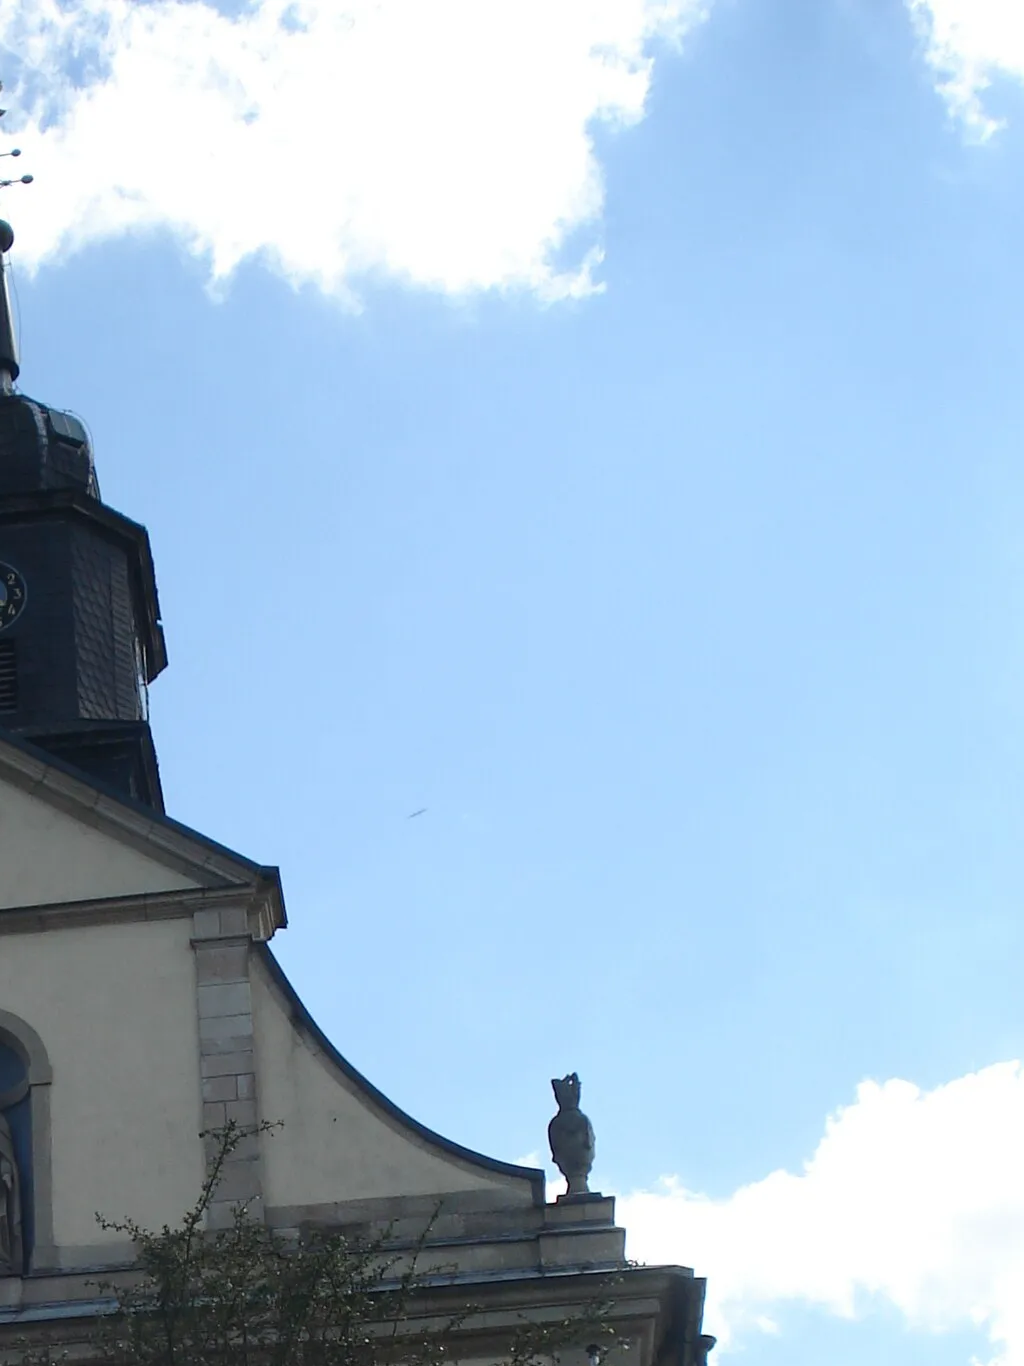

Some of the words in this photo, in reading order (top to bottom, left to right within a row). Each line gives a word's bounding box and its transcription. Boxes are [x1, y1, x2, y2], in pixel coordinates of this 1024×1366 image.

[7, 573, 15, 585] 2
[13, 588, 22, 599] 3
[8, 604, 16, 615] 4
